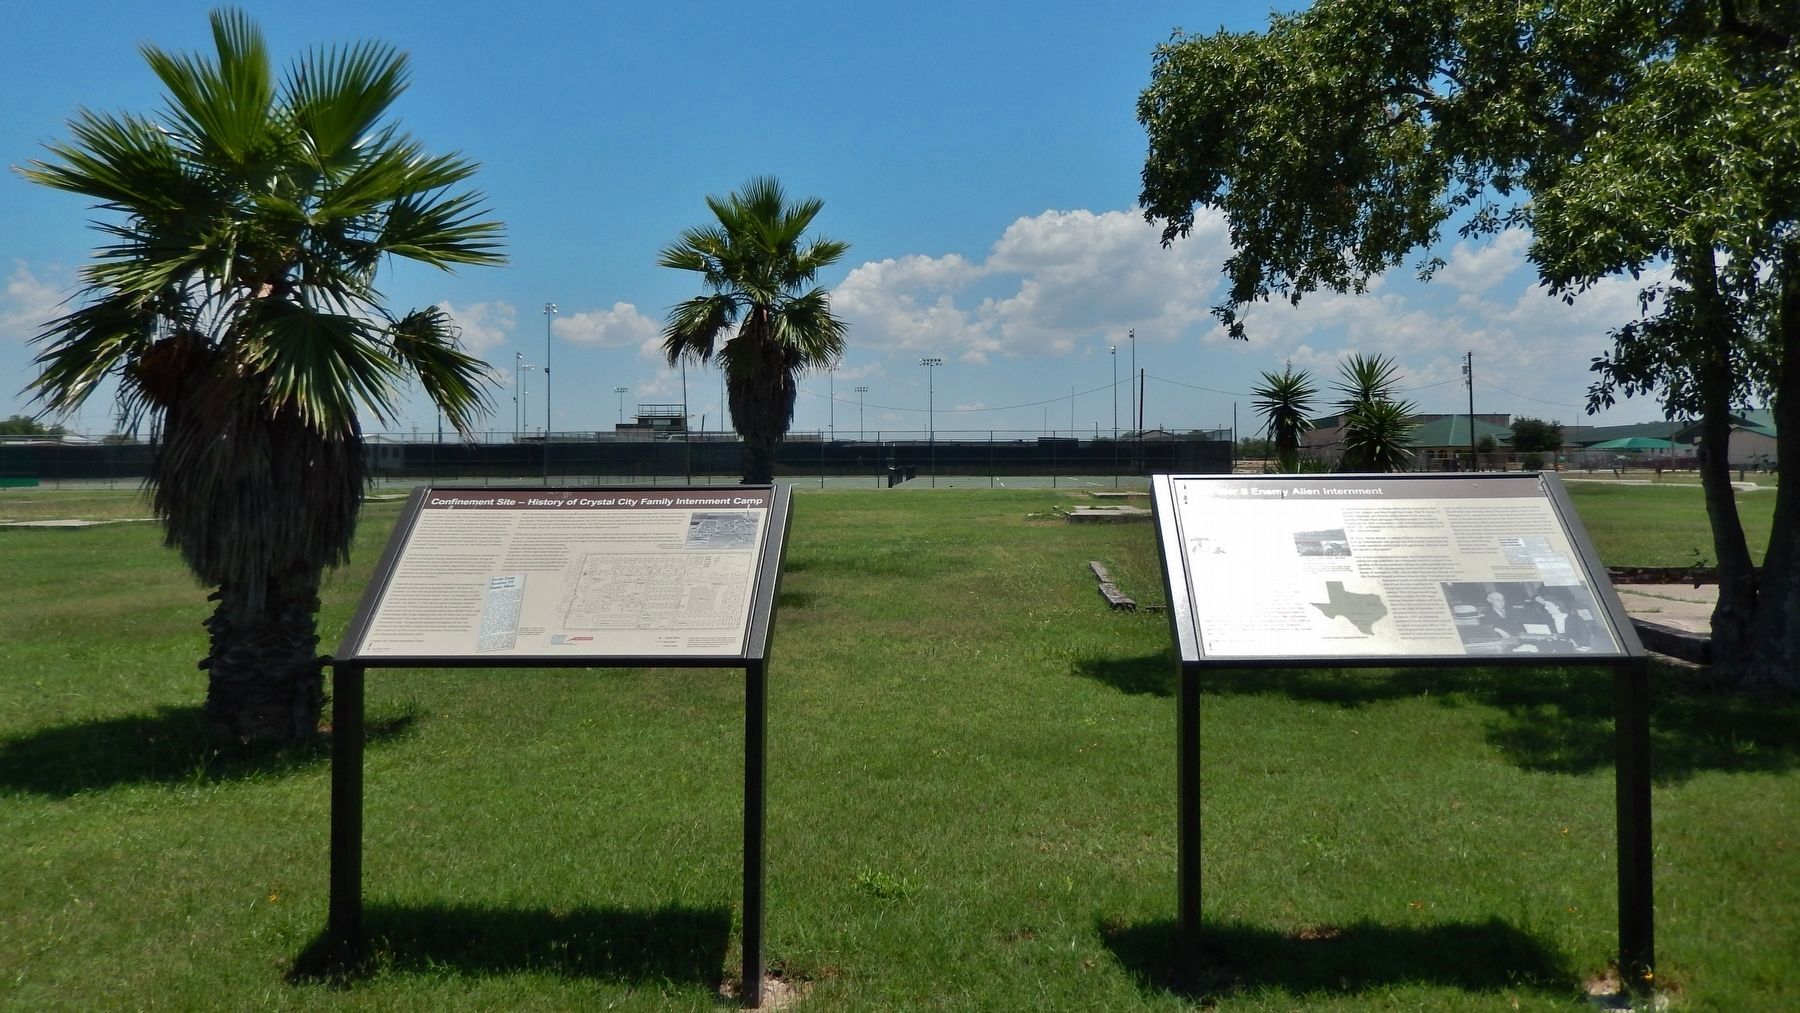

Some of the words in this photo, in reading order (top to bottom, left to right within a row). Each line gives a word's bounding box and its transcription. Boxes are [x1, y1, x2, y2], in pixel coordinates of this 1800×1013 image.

[1251, 487, 1289, 497] Enemy
[1292, 487, 1320, 495] Alien
[1323, 487, 1384, 495] Internment
[431, 498, 494, 506] Confinement
[528, 498, 564, 507] History
[566, 498, 578, 506] of
[580, 498, 615, 507] Crystal
[617, 498, 638, 507] City
[640, 498, 675, 506] Family
[676, 497, 731, 505] Internment
[733, 497, 763, 506] Camp
